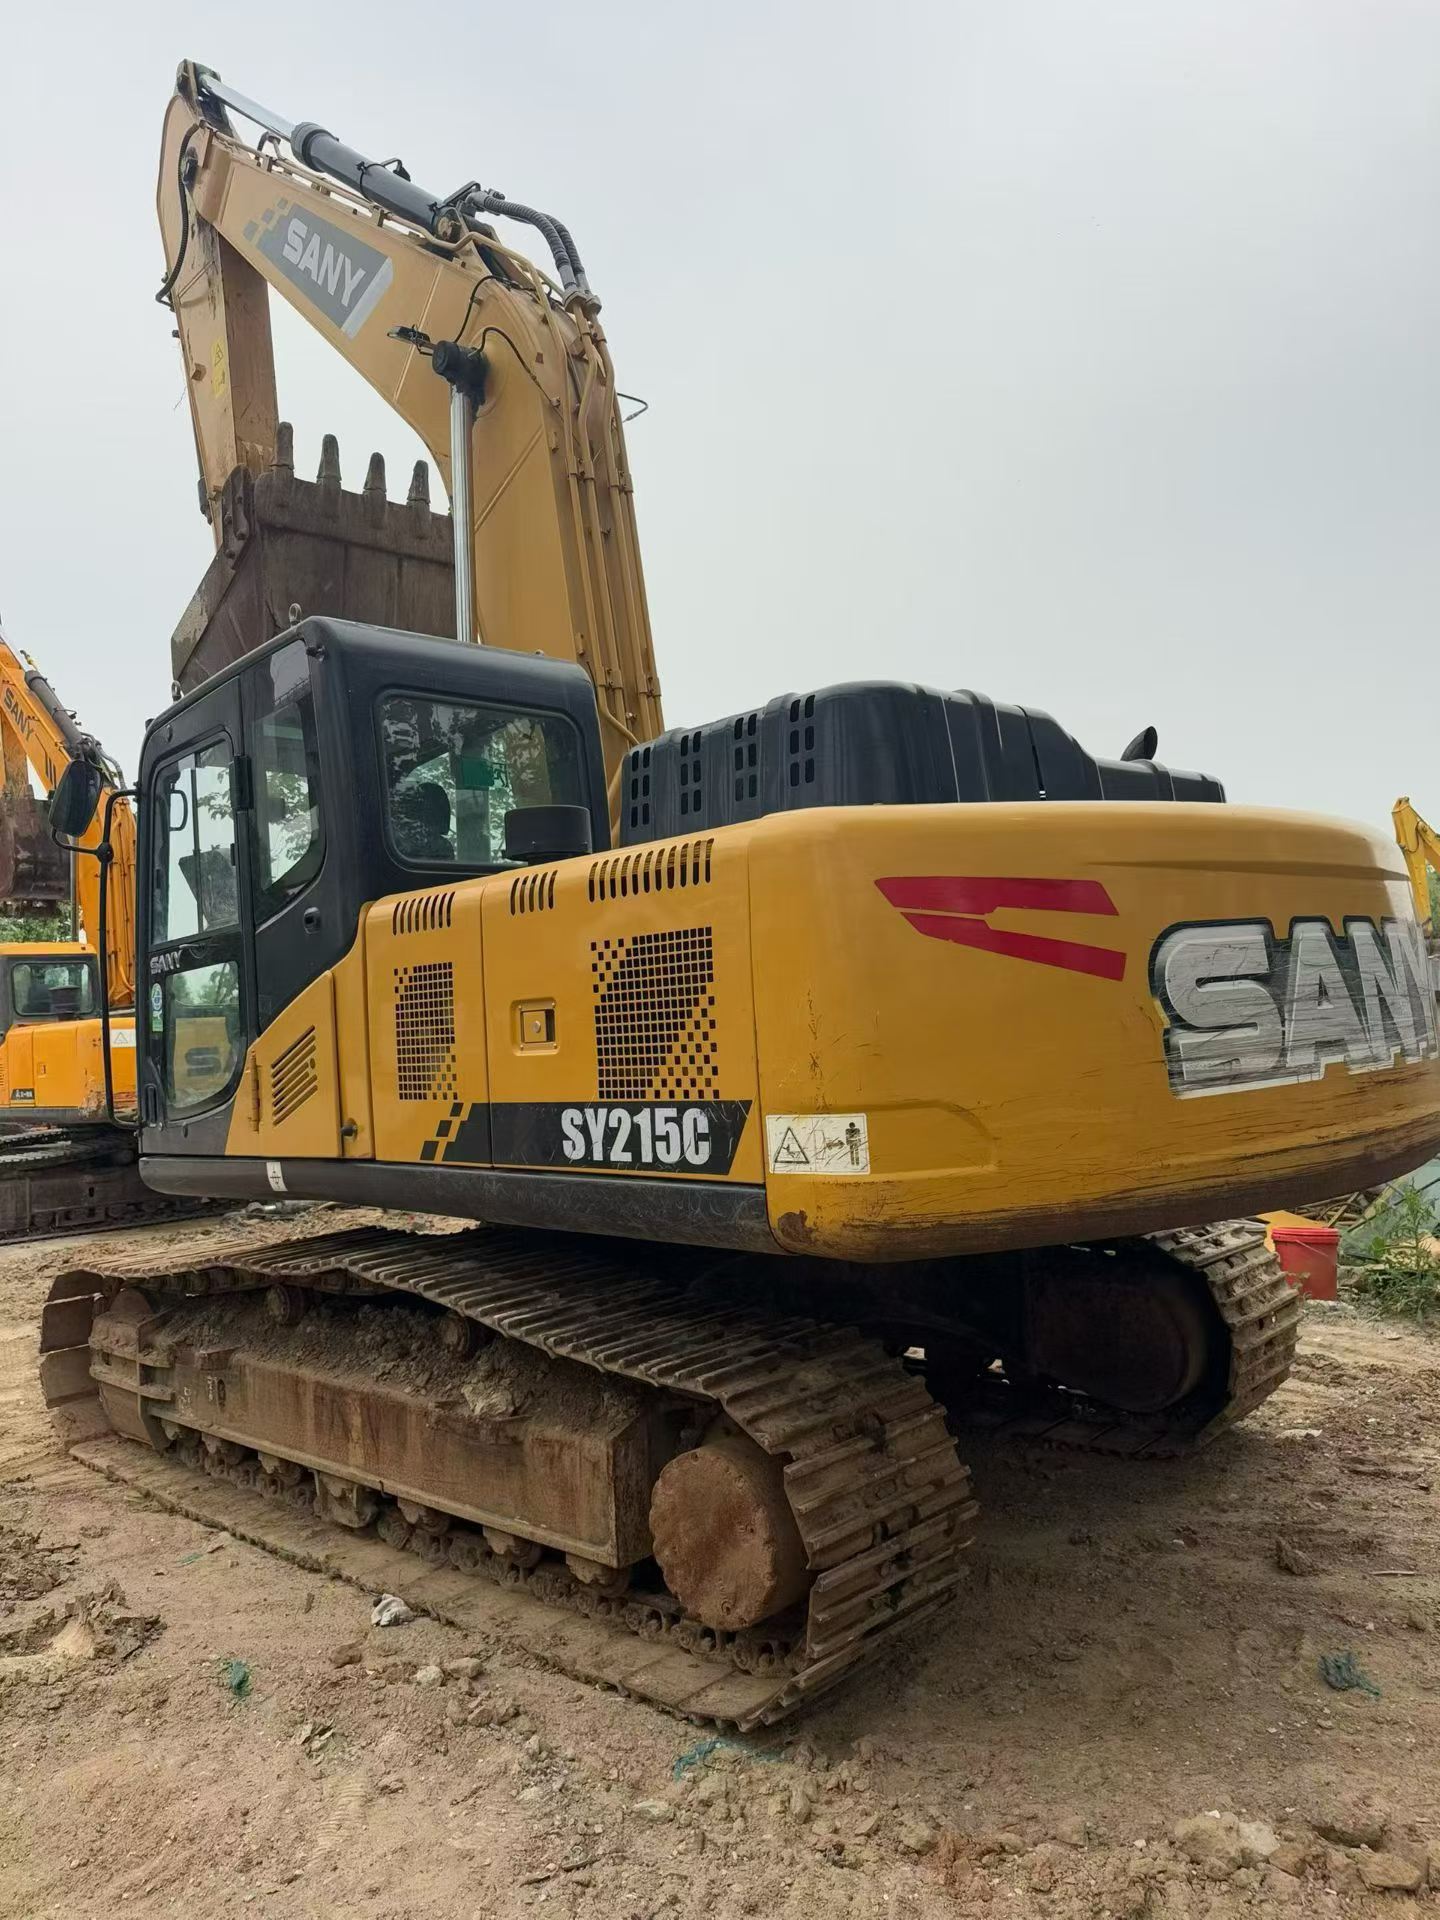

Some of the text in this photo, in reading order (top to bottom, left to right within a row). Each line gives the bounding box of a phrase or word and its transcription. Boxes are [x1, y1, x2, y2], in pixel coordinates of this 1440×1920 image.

[283, 218, 366, 307] SANY
[4, 687, 33, 741] SANY
[150, 949, 183, 975] SANY
[561, 1107, 710, 1165] SY215C
